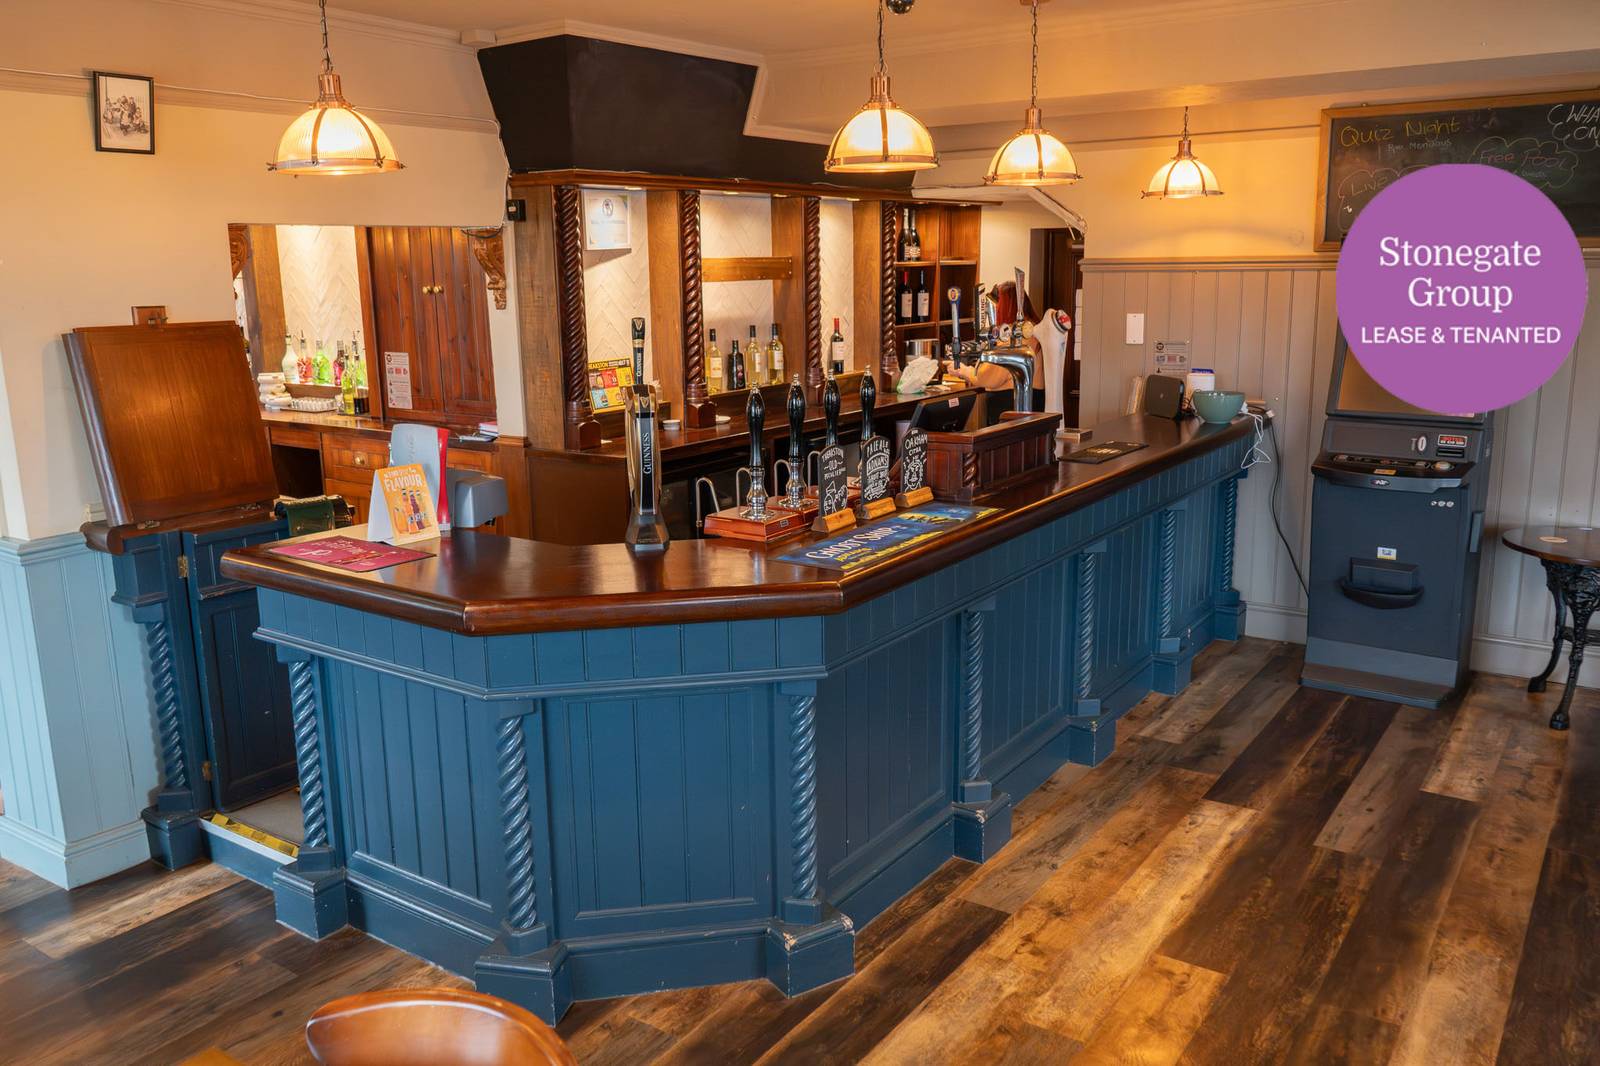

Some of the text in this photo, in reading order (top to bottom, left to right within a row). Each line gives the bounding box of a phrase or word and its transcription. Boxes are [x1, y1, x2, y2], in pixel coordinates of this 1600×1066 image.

[1340, 116, 1461, 147] Quiz Night
[905, 434, 928, 450] OAKHAM
[642, 432, 652, 475] GUINNESS
[384, 473, 423, 492] FLAVOUR
[805, 538, 869, 560] GHOST
